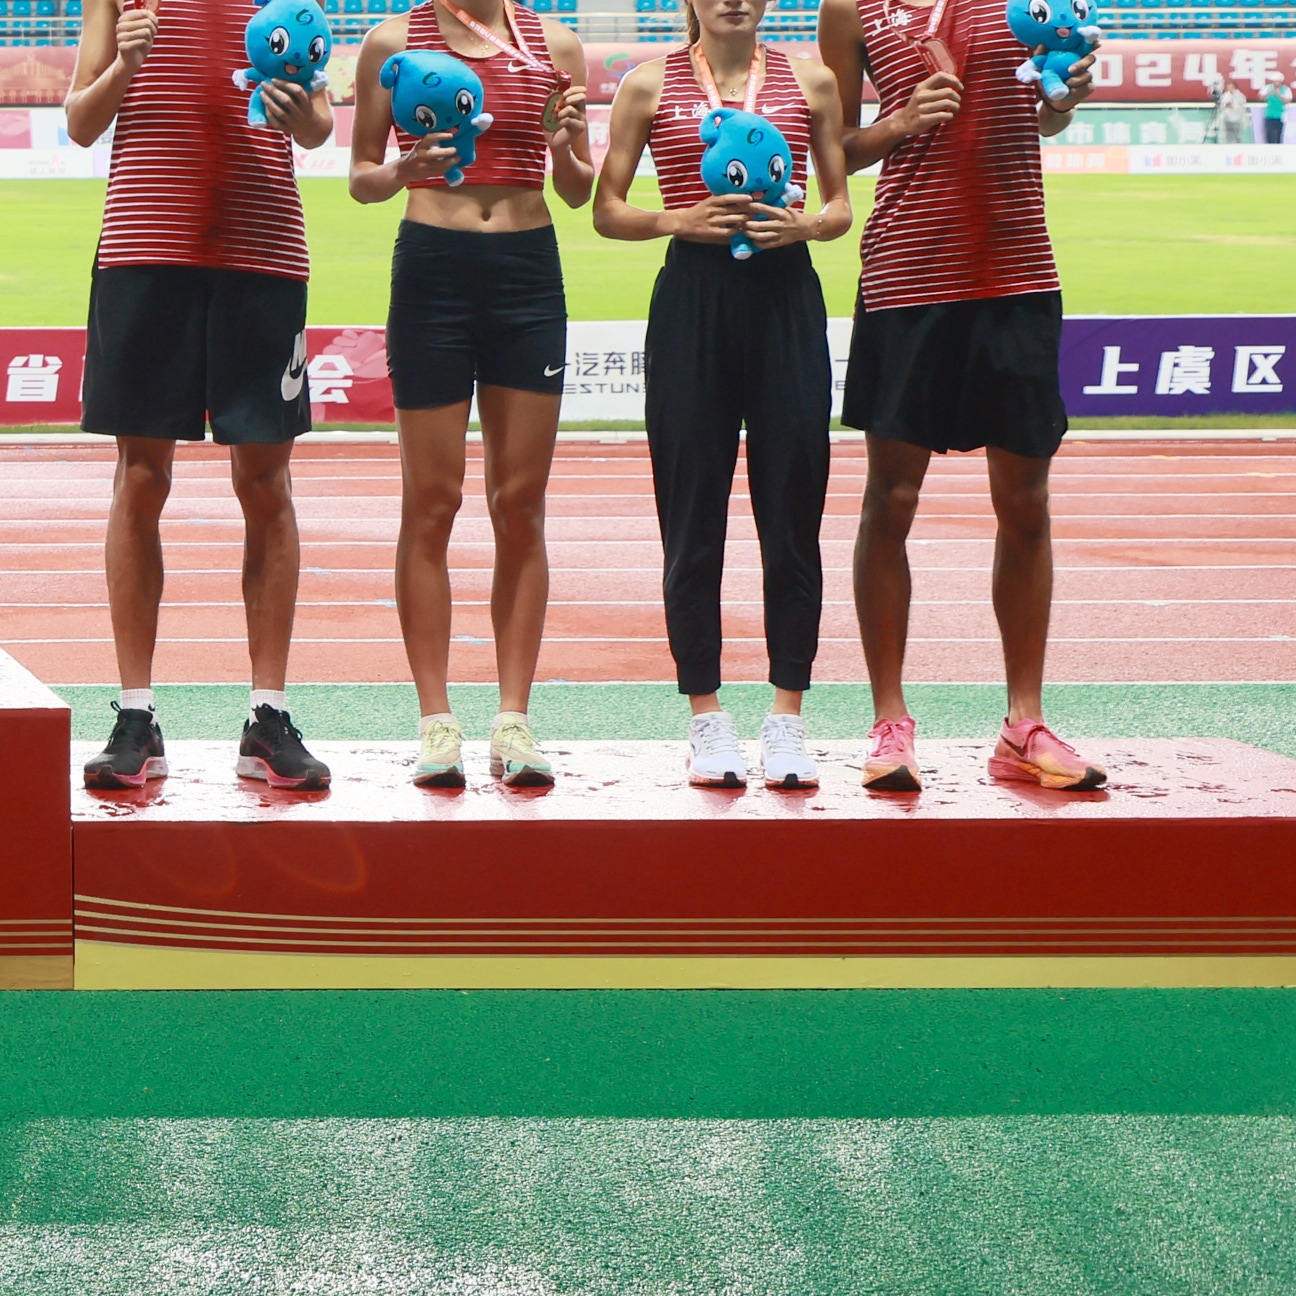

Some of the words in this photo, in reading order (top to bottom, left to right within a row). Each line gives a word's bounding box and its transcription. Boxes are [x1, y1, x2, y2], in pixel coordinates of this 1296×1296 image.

[1083, 344, 1287, 395] 上虞区
[564, 383, 647, 395] ESTUN
